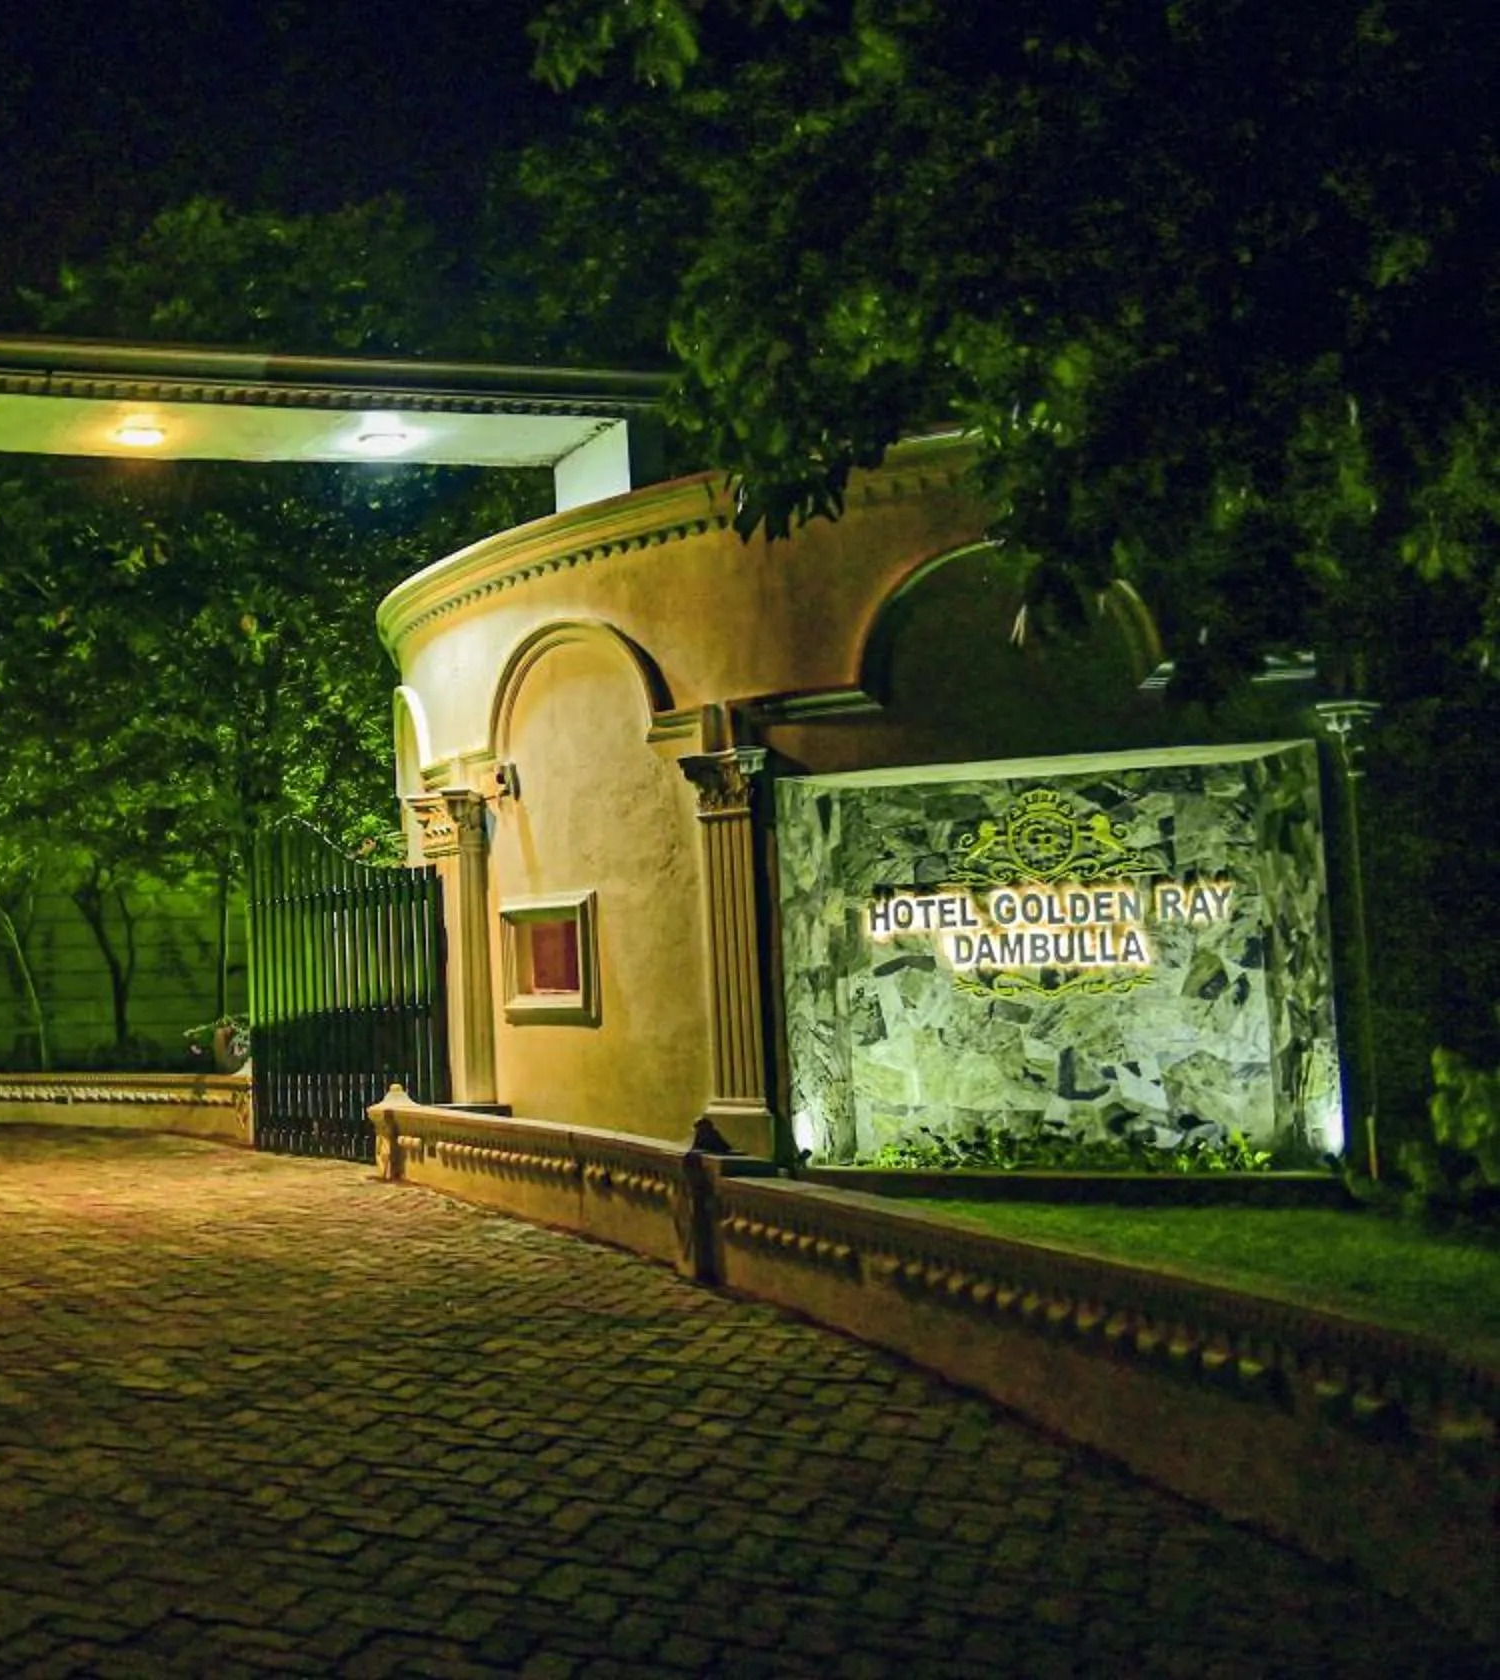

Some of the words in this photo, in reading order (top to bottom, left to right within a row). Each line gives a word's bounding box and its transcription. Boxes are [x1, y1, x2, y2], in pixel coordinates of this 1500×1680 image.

[869, 896, 978, 932] HOTEL
[993, 890, 1142, 925] GOLDEN
[1159, 886, 1232, 922] RAY
[954, 929, 1145, 965] DAMBULLA
